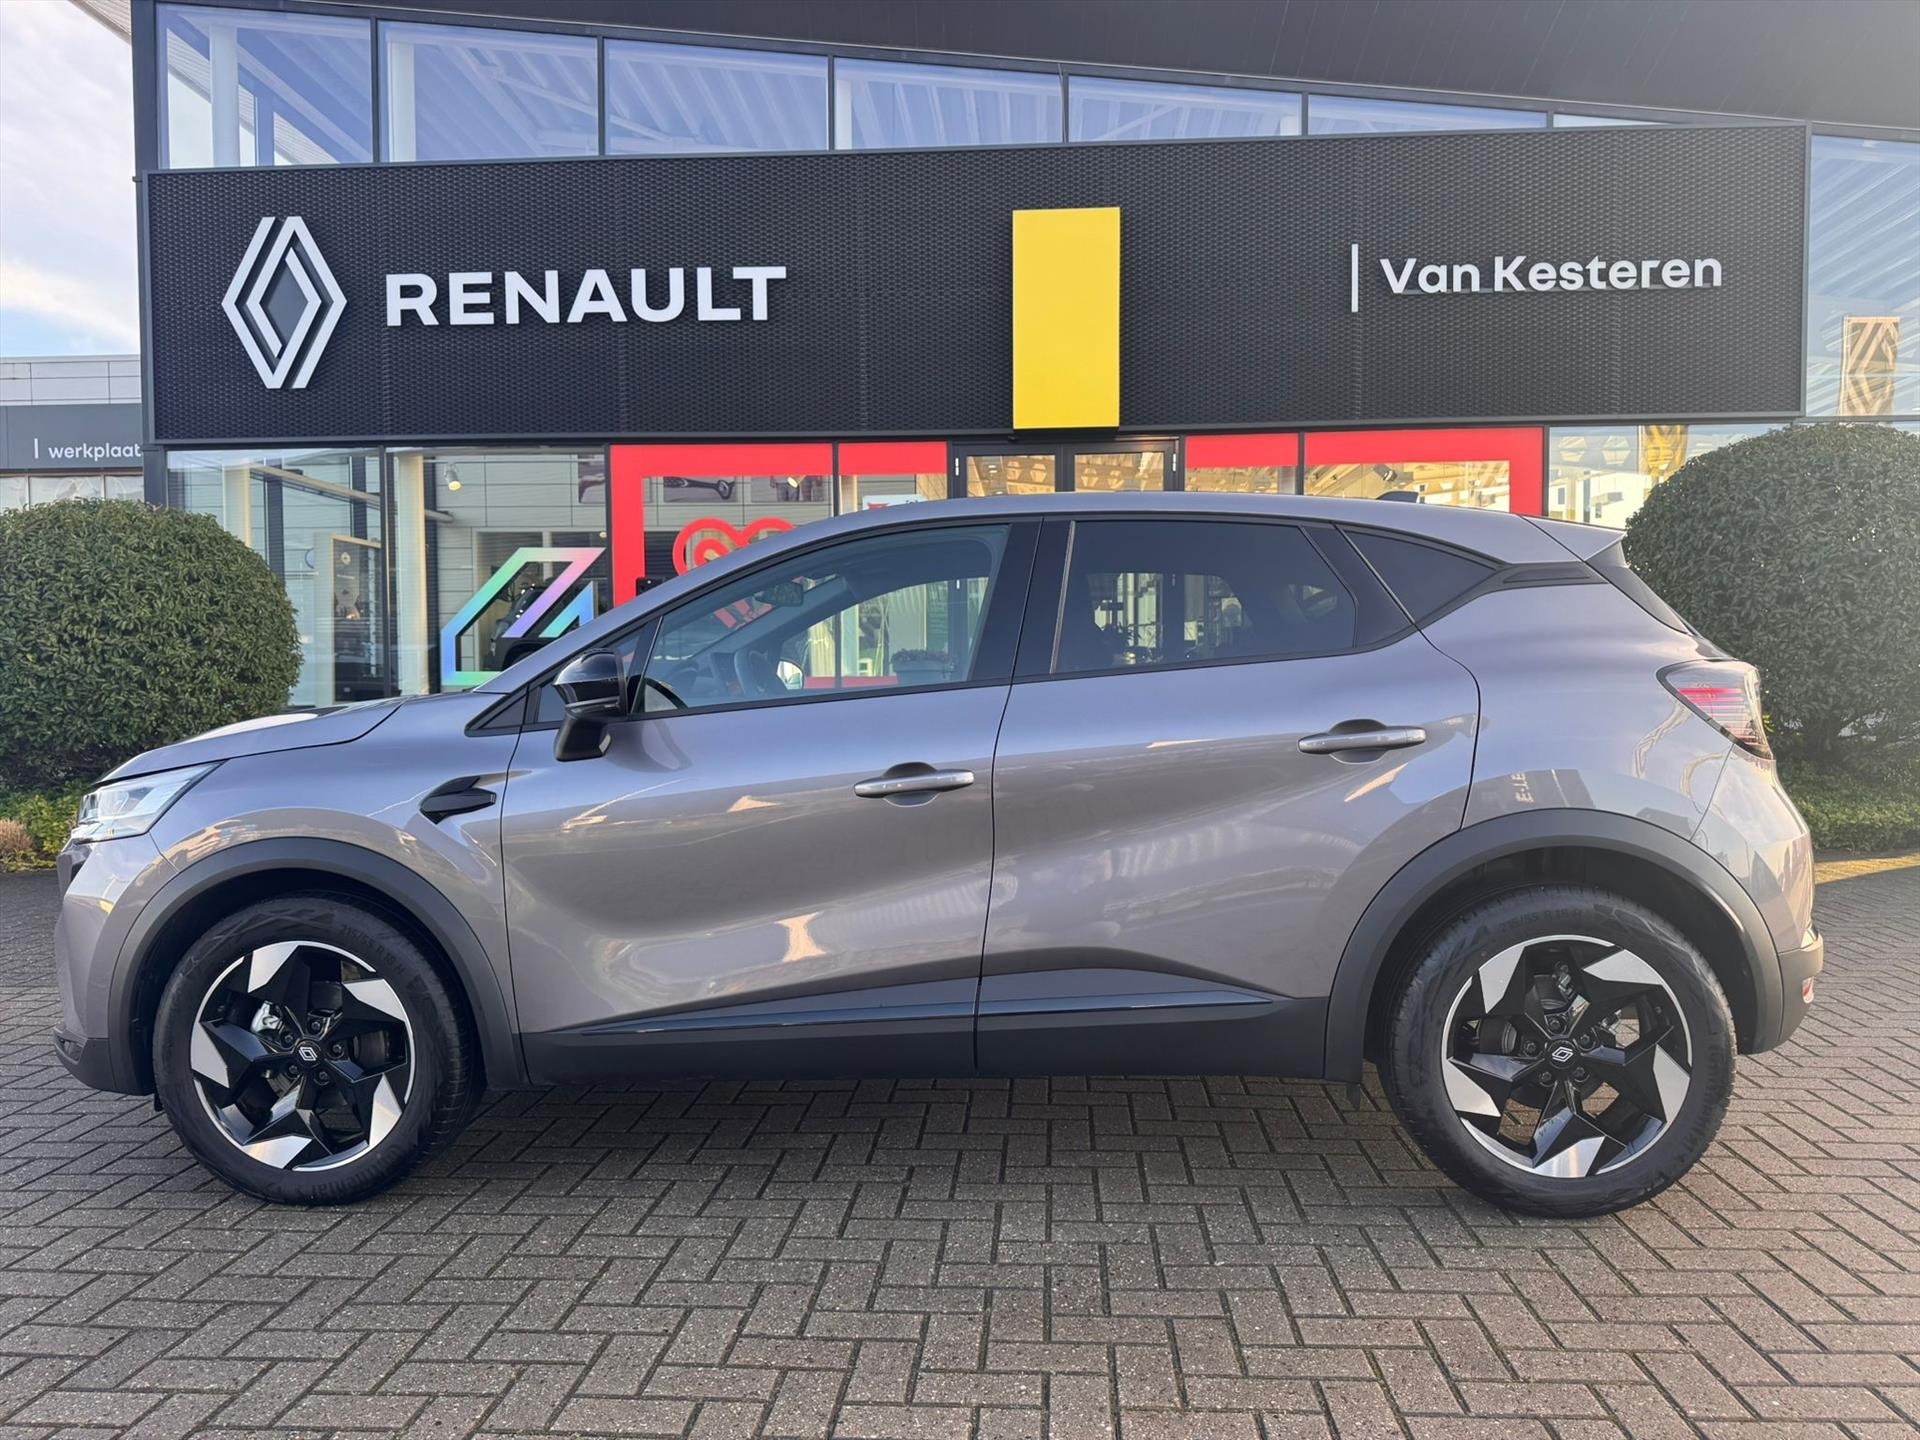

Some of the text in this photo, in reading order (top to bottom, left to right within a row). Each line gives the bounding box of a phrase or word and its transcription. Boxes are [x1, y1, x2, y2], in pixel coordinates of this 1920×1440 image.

[386, 266, 787, 326] RENAULT
[1379, 255, 1722, 293] Van Kesteren
